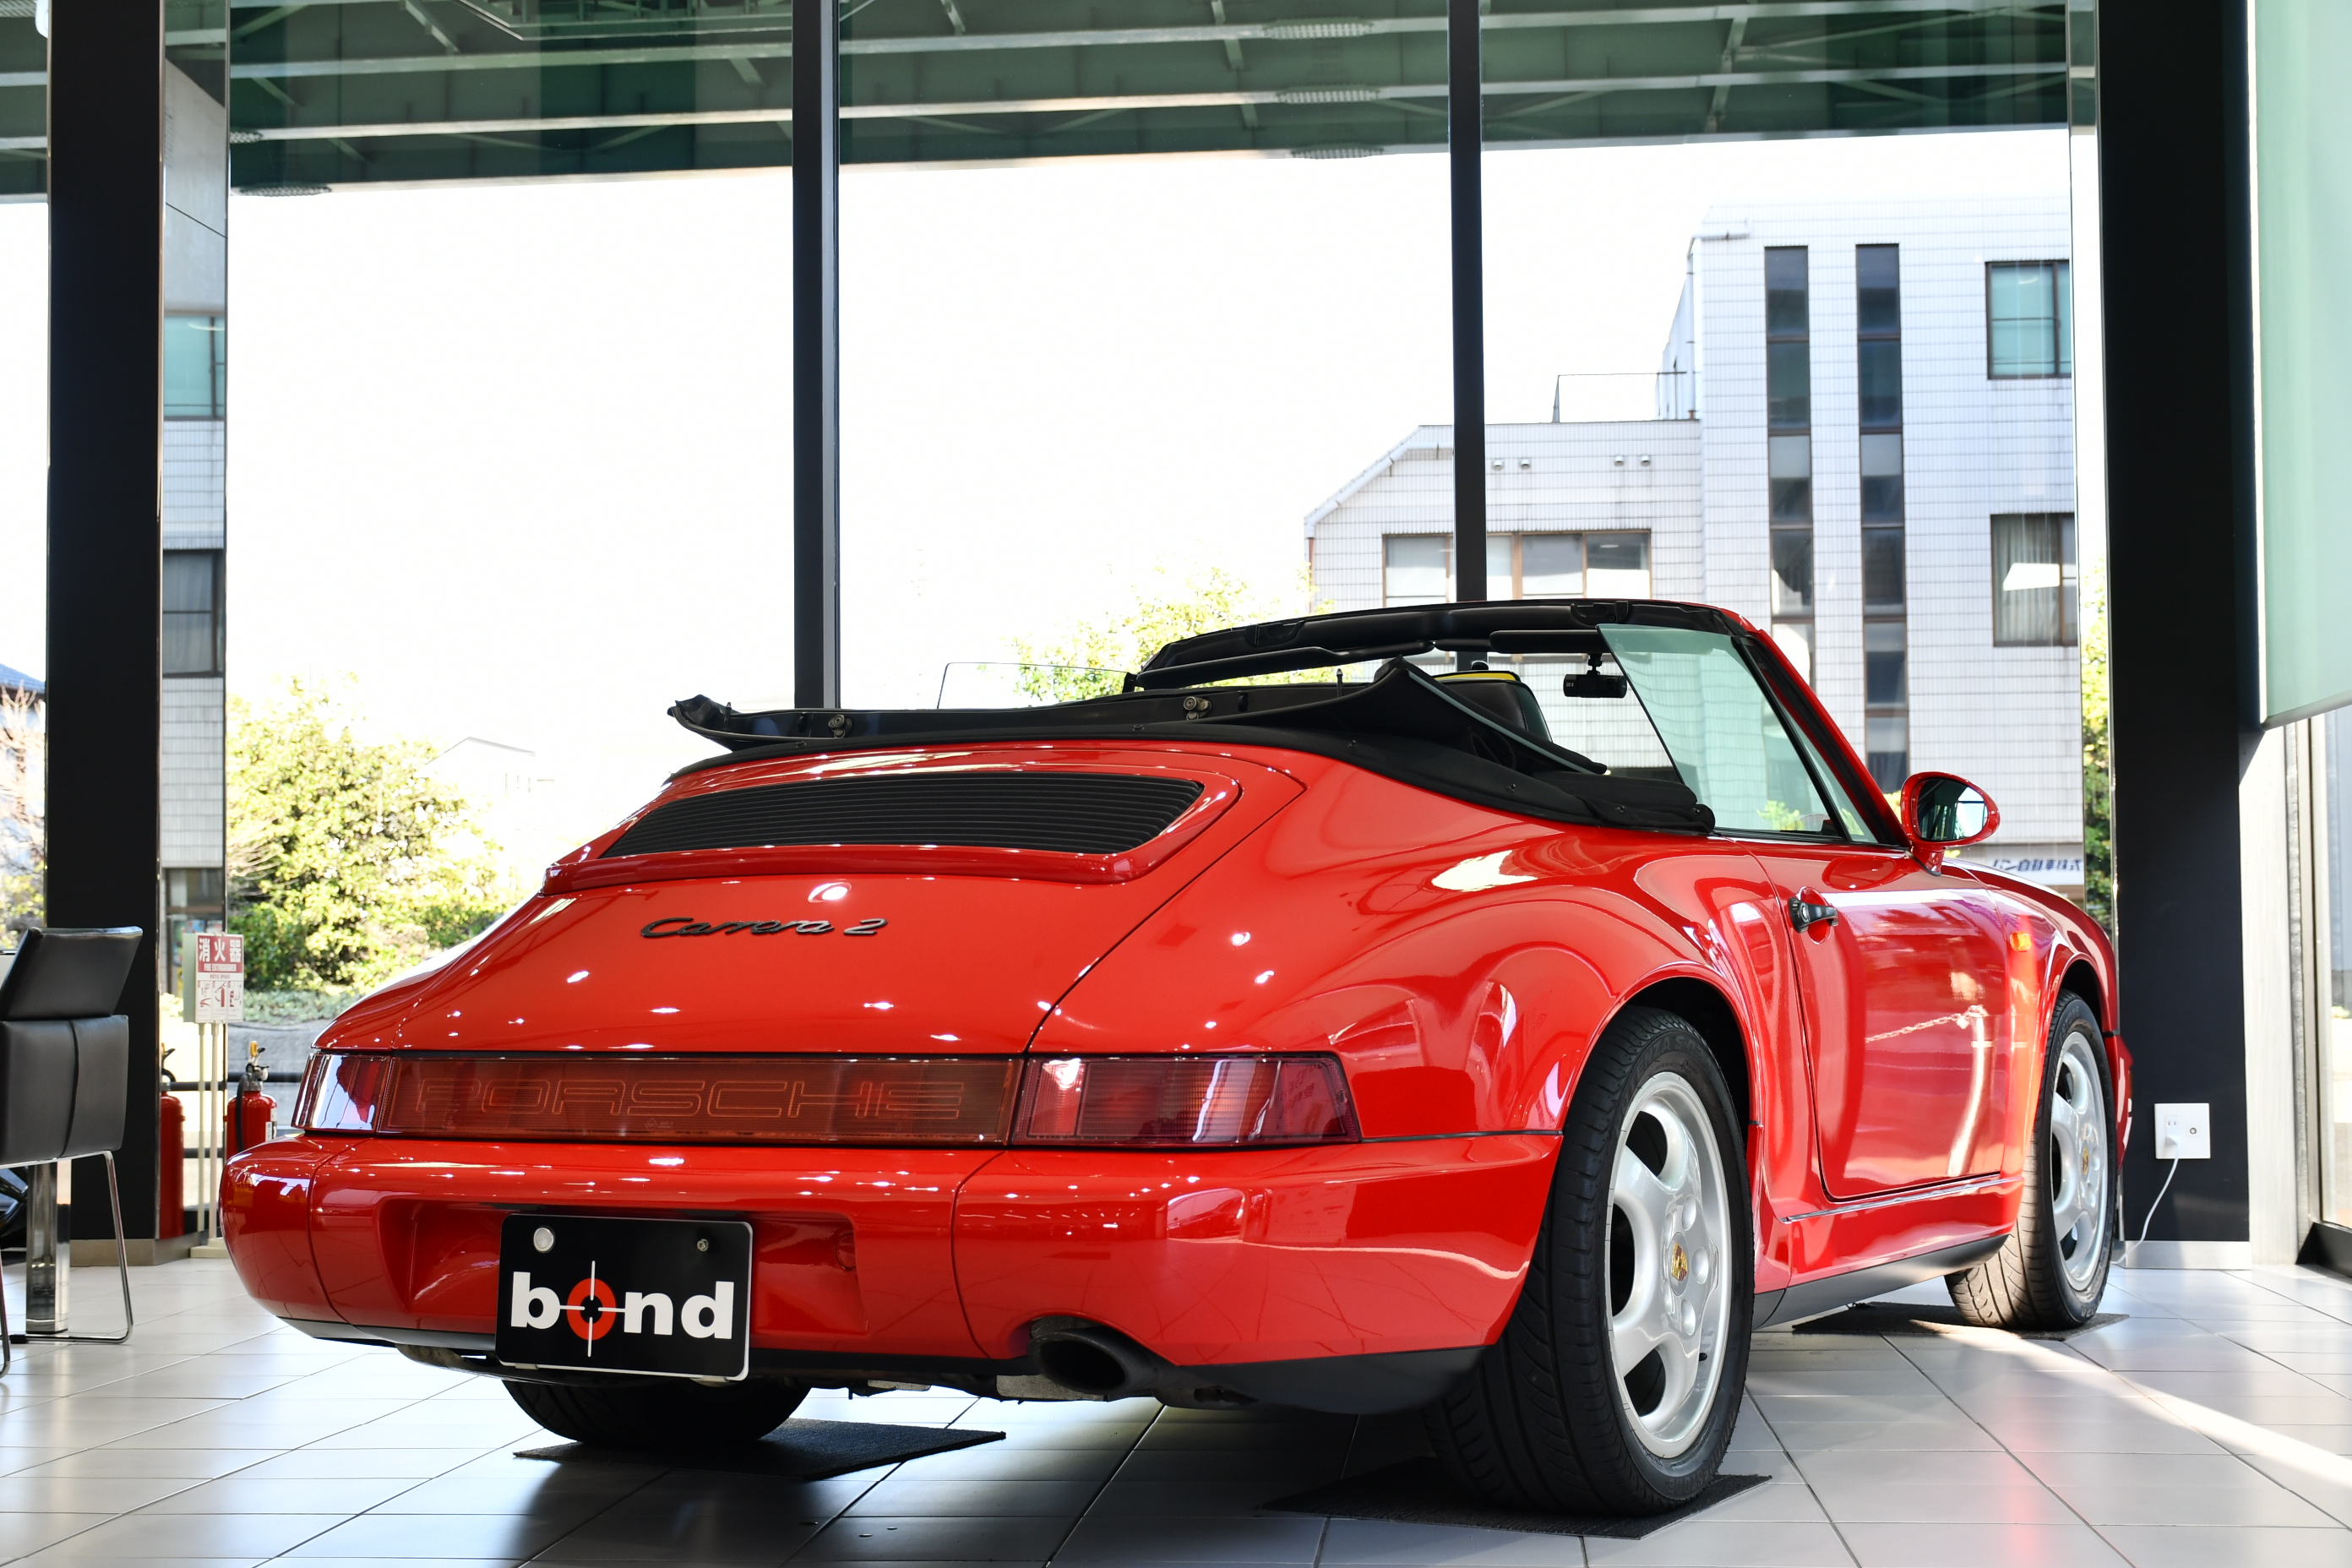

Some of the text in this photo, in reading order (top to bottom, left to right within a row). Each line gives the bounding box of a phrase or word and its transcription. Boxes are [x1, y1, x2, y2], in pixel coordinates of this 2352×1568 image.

[640, 917, 888, 938] Carrera 2
[199, 938, 242, 962] 消火器
[416, 1078, 964, 1119] PORSCHE
[510, 1271, 735, 1341] bond
